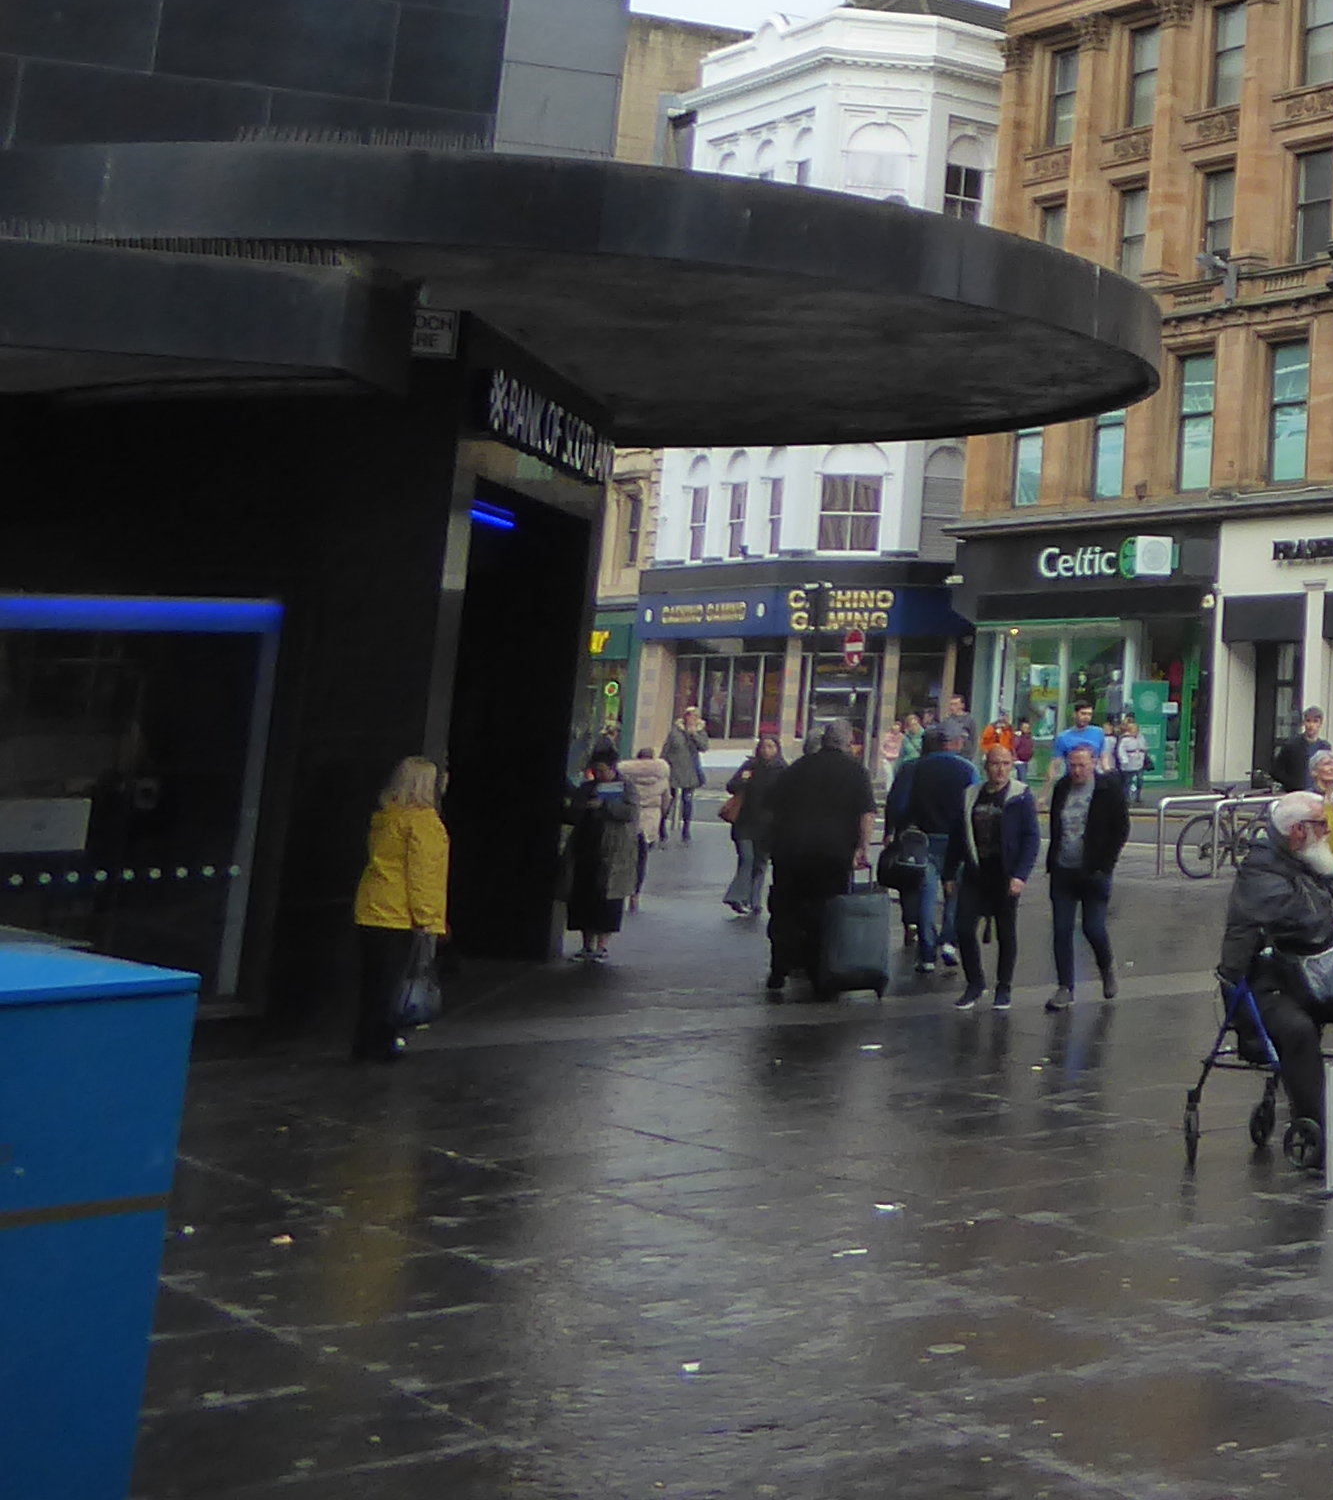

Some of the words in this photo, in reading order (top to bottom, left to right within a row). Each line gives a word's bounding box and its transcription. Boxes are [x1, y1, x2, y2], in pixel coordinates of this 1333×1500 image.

[1039, 547, 1117, 578] Celtic
[788, 589, 895, 609] CHINO
[790, 611, 889, 630] GMING
